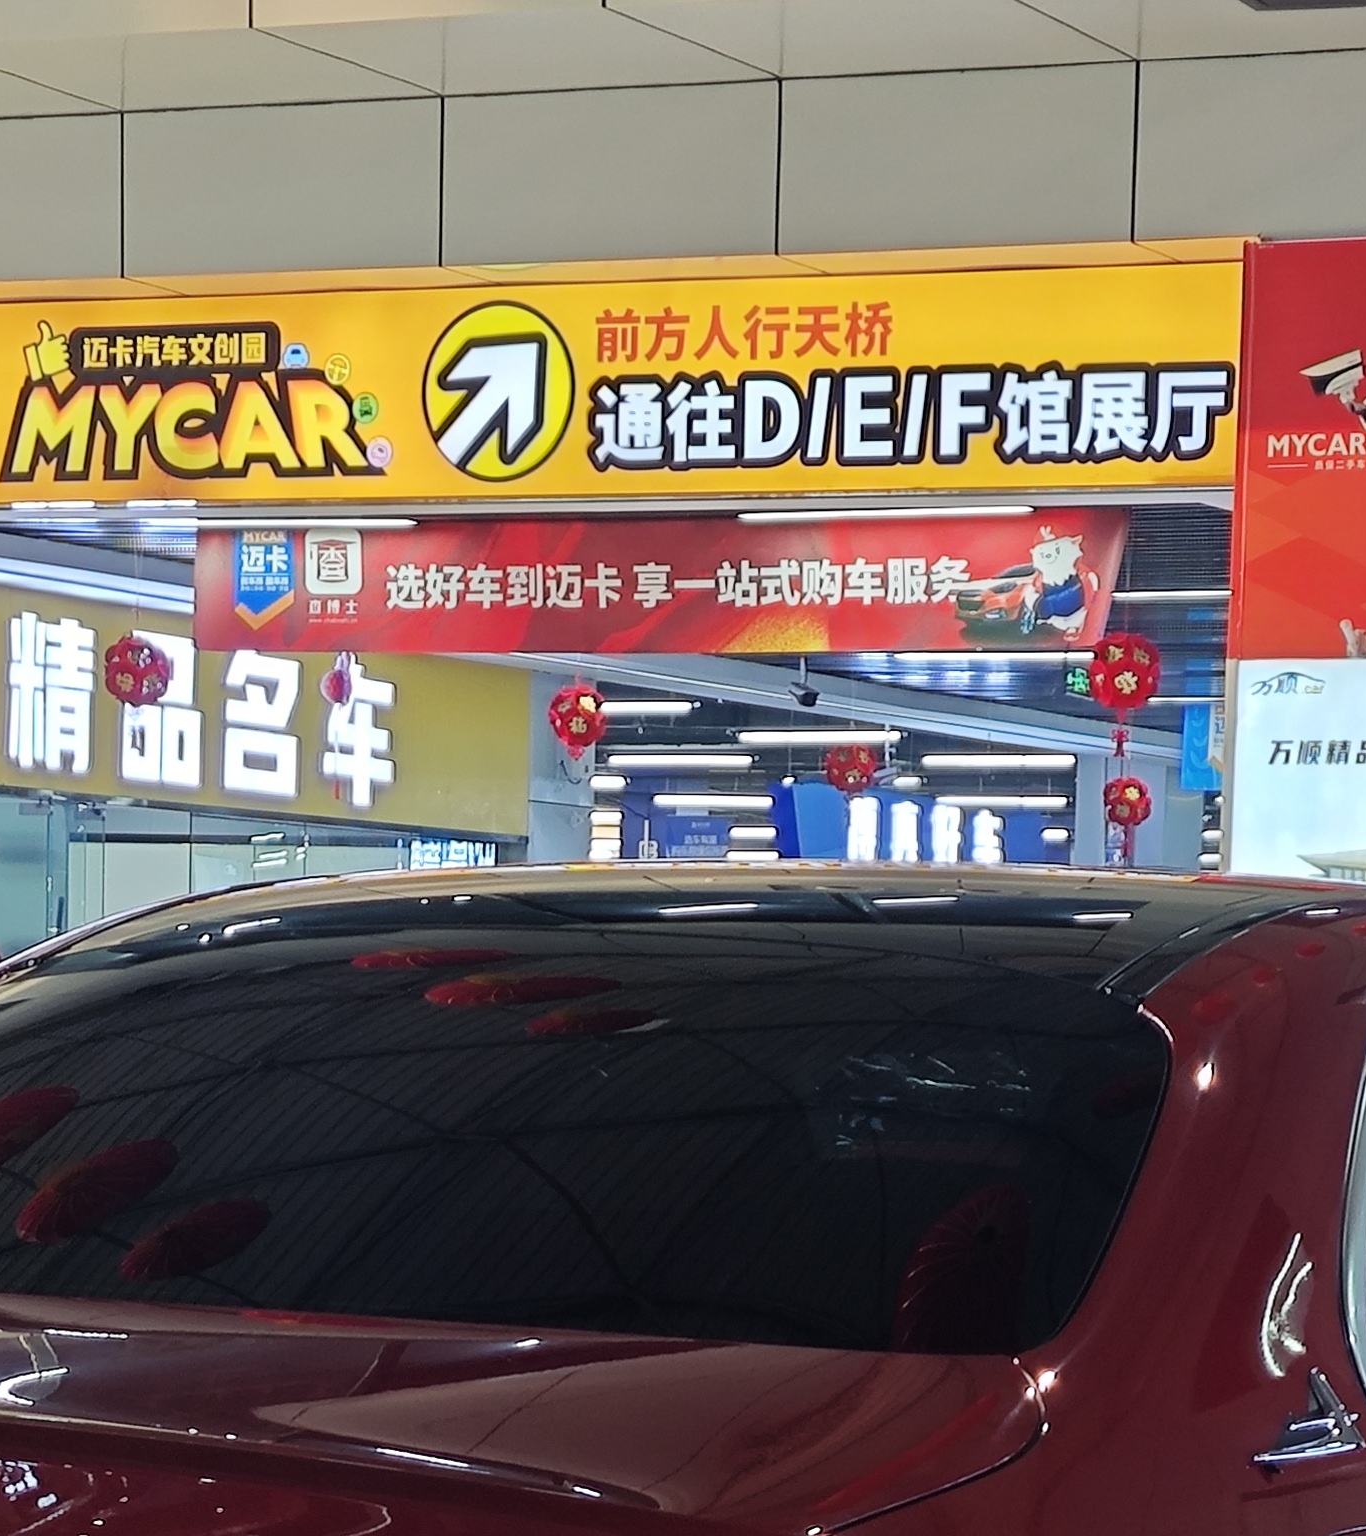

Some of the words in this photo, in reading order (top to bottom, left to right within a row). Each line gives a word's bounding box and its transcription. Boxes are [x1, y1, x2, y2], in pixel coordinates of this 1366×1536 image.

[81, 331, 269, 369] 迈卡汽车文创园
[596, 302, 893, 363] 前方人行天桥
[9, 378, 368, 476] MYCAR
[595, 370, 1229, 463] 通往D/E/F馆展厅
[240, 545, 290, 573] 迈卡
[385, 564, 622, 612] 选好车到迈卡
[633, 555, 971, 611] 享一站式购车服务
